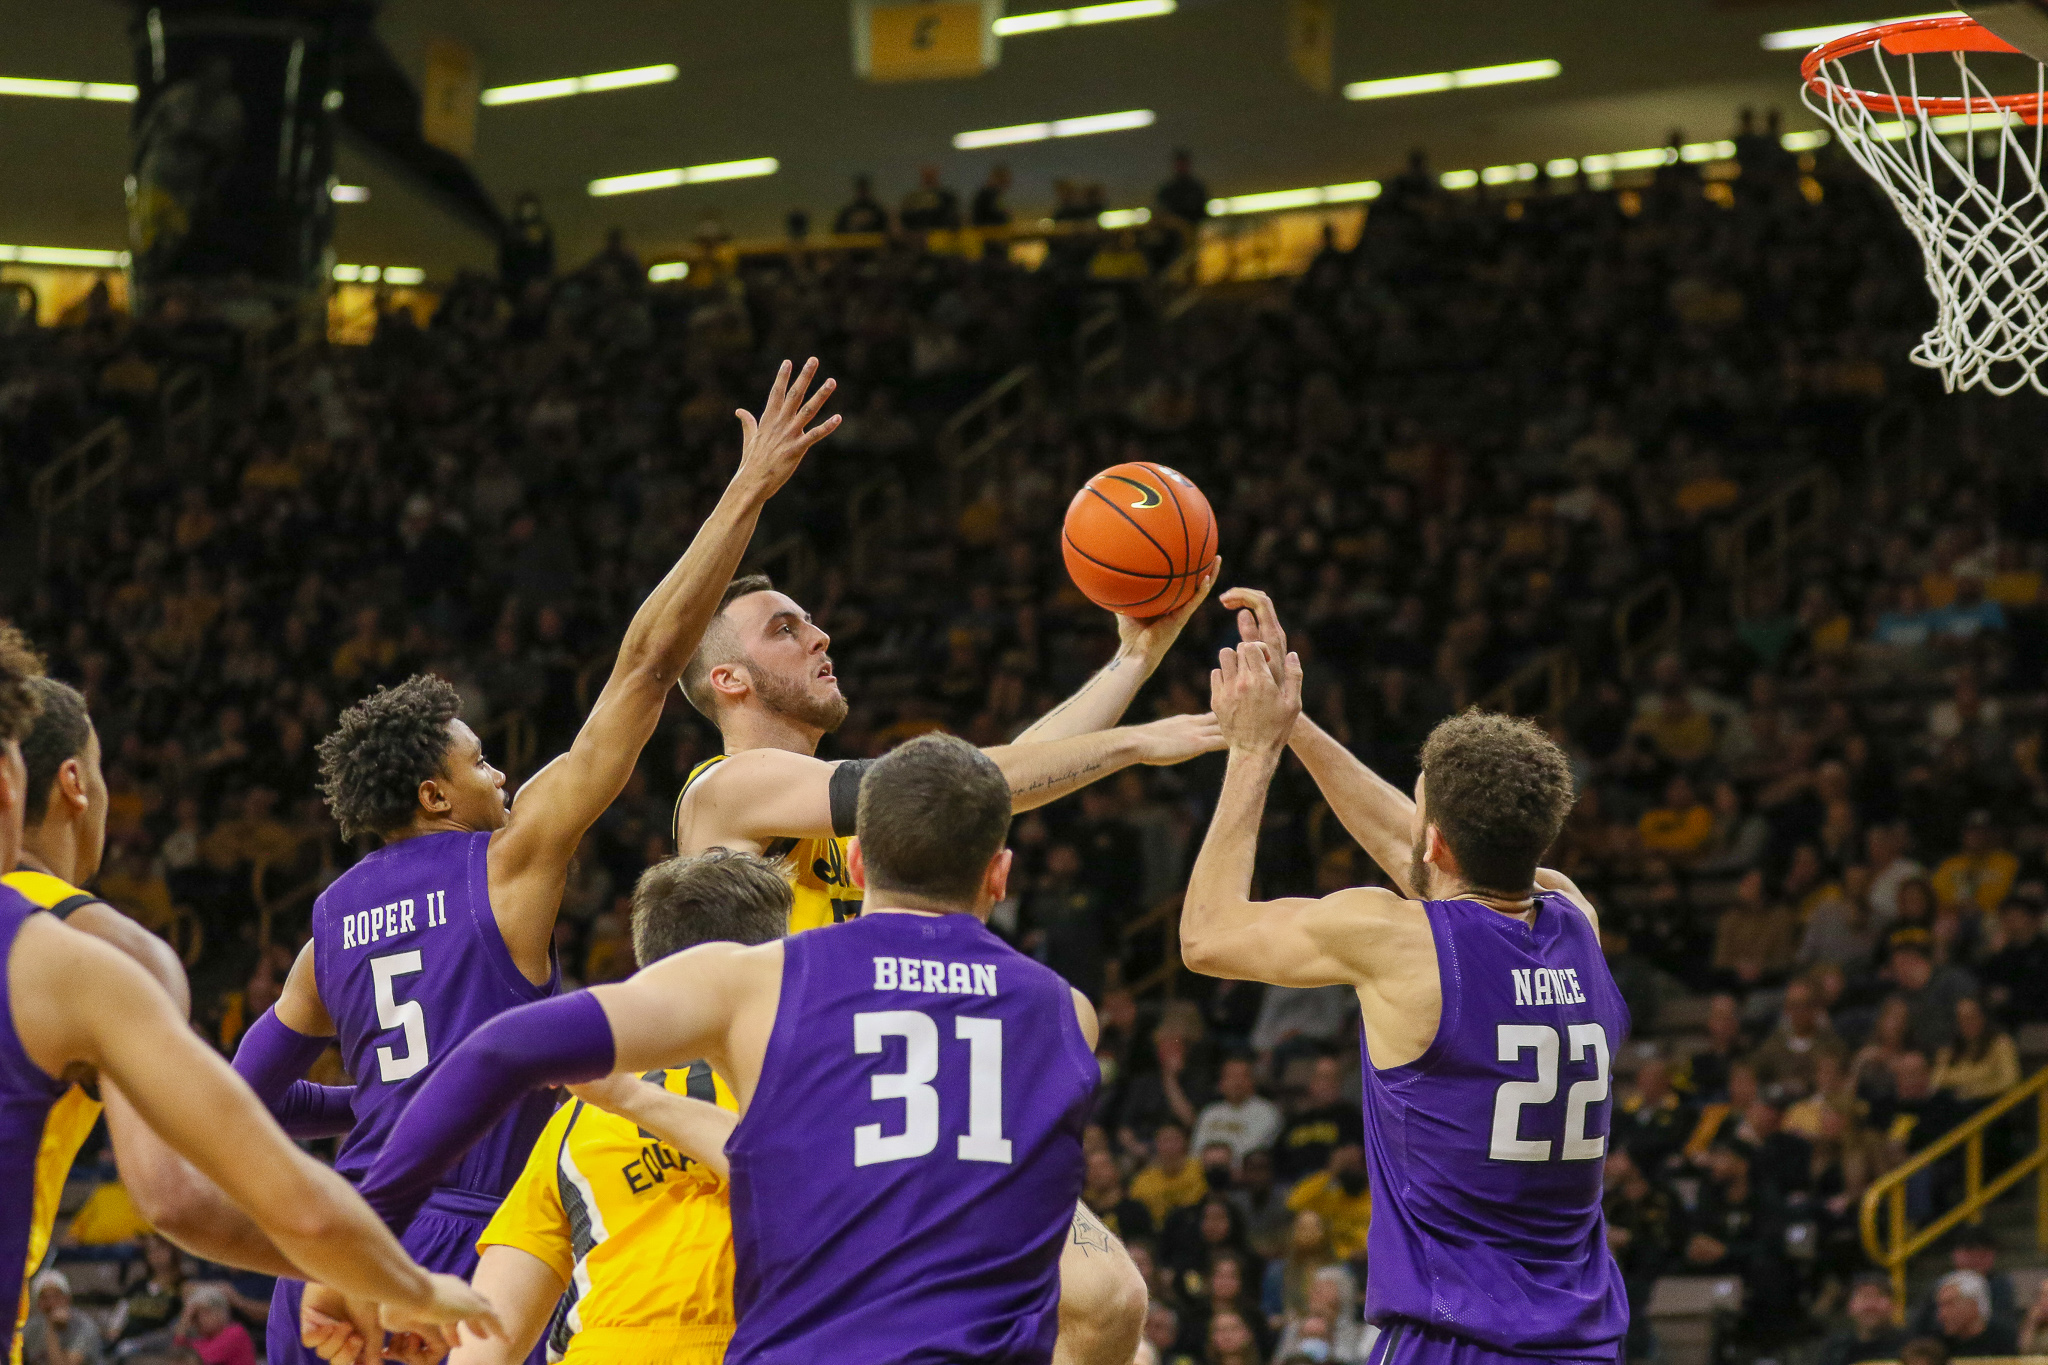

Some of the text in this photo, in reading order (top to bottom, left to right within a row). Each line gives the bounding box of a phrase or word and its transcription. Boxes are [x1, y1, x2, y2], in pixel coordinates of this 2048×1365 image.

[342, 890, 447, 950] ROPER II
[369, 949, 430, 1083] 5
[872, 955, 998, 997] BERAN
[1510, 967, 1587, 1006] NANCE
[853, 1009, 1013, 1168] 31
[1489, 1022, 1611, 1162] 22
